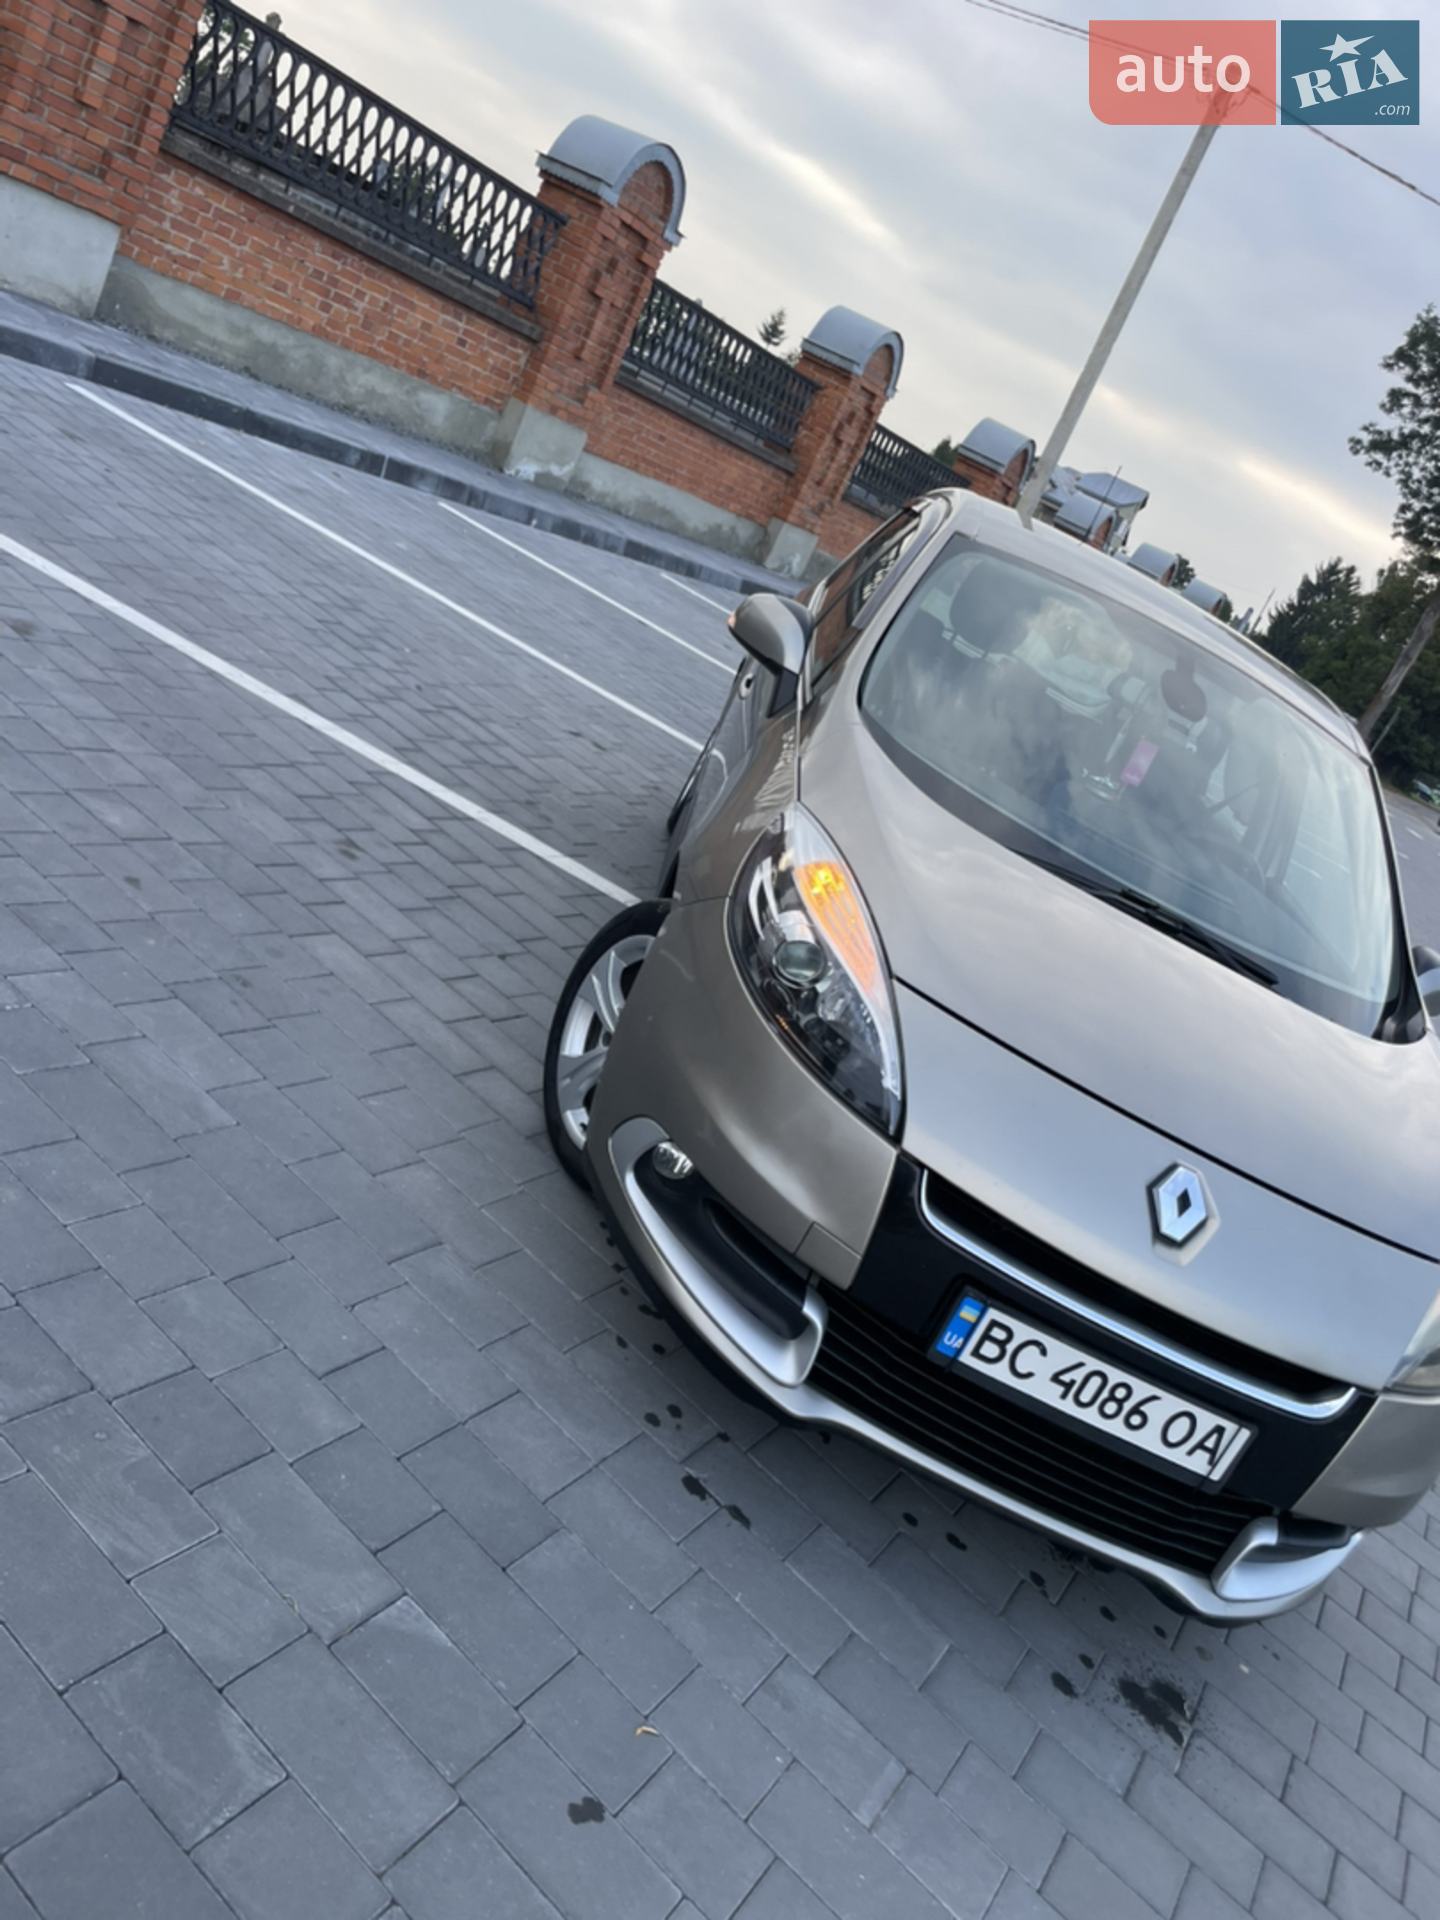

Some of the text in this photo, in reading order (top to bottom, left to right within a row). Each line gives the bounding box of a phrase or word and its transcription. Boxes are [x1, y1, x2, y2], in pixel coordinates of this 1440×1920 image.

[943, 1331, 965, 1349] UA
[969, 1318, 1227, 1467] BC 4086 OA
